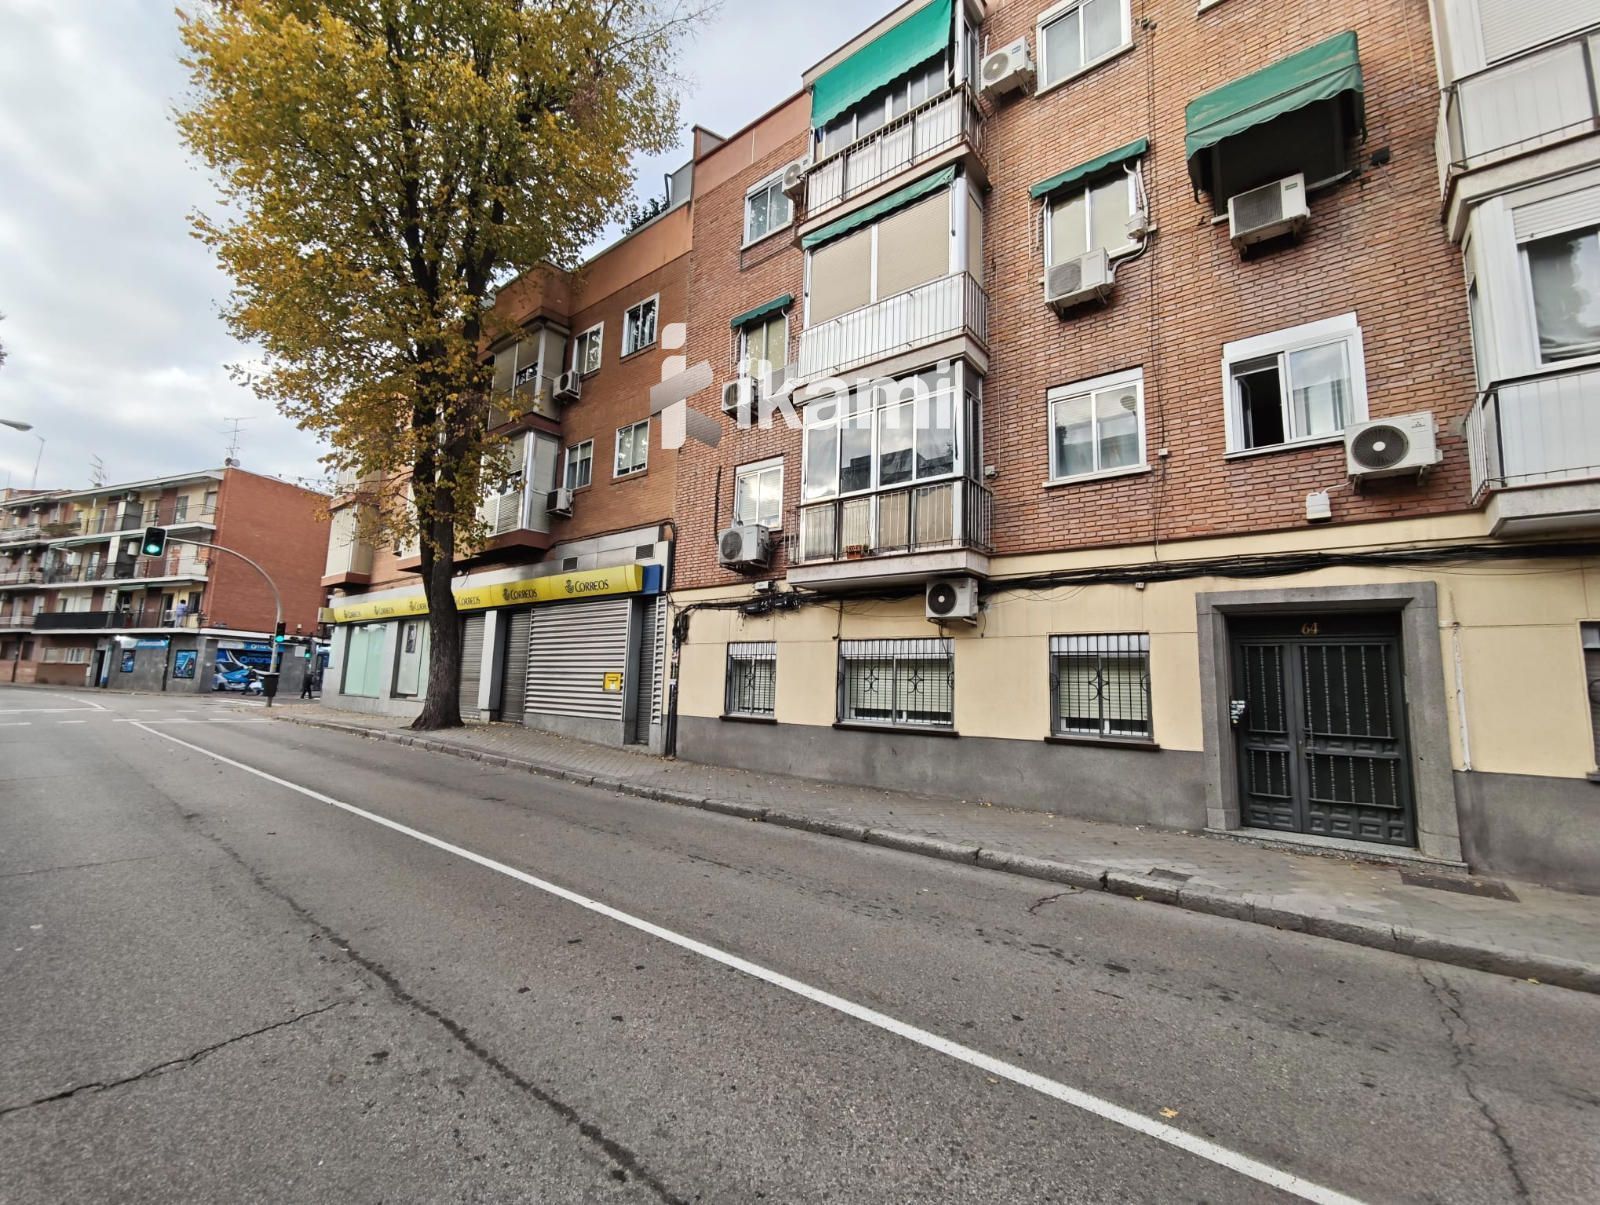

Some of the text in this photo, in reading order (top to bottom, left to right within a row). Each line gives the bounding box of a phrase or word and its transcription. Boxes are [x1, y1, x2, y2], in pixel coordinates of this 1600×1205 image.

[574, 578, 609, 593] CORREOS
[510, 588, 538, 600] CORREOS
[1301, 622, 1318, 635] 64
